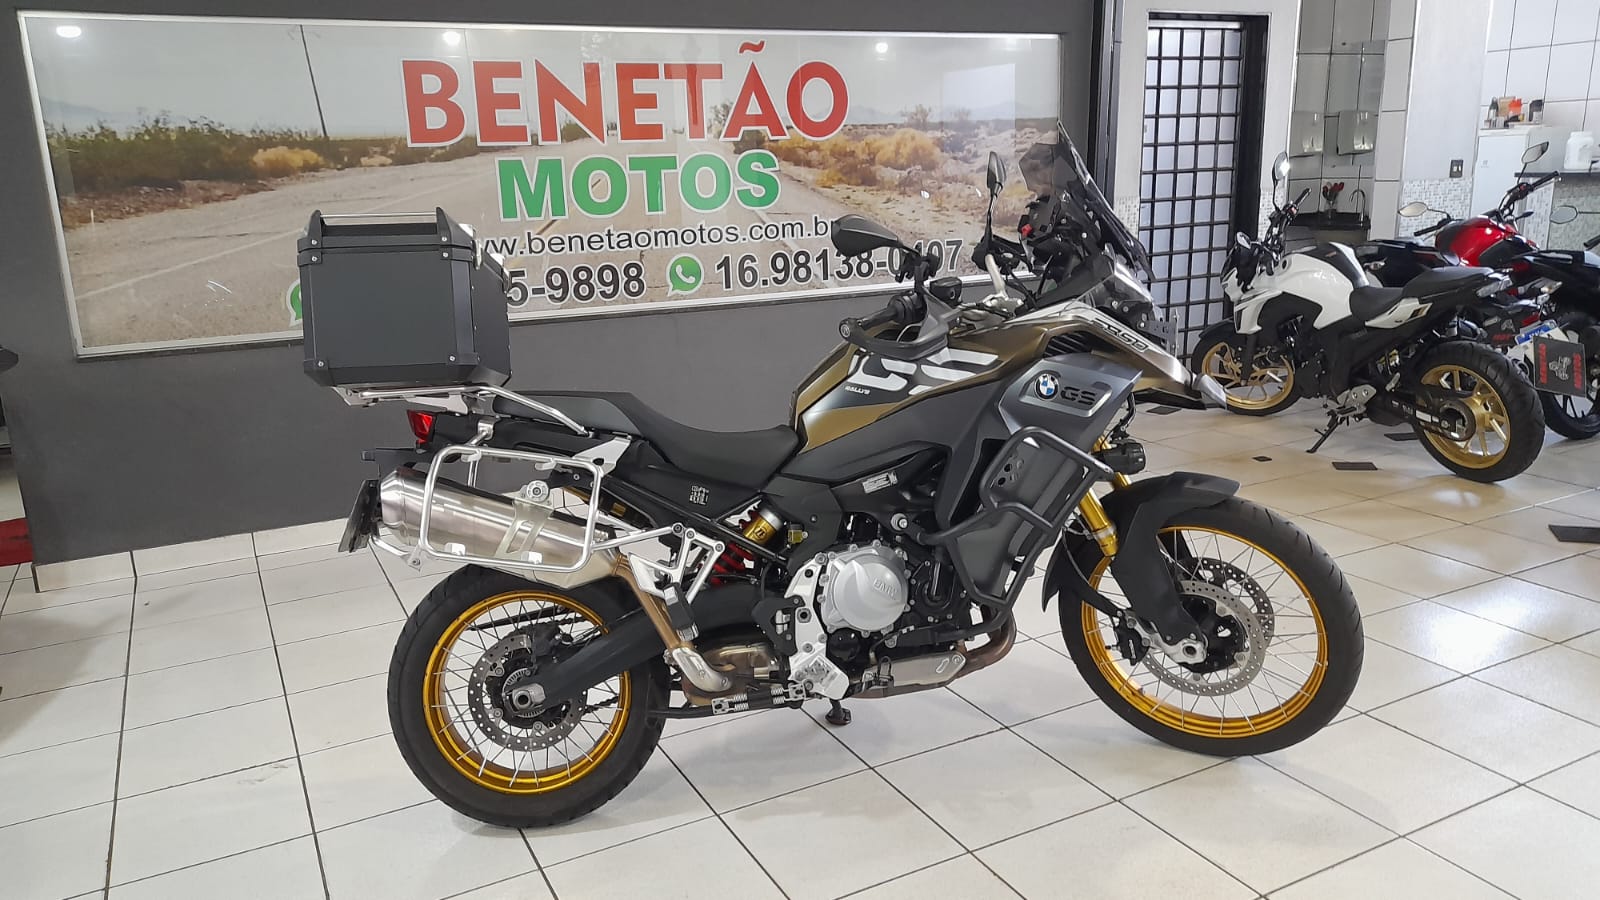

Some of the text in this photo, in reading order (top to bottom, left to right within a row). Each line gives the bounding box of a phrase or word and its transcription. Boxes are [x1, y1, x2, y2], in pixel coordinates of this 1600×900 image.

[401, 40, 849, 145] BENETÃO
[498, 149, 780, 219] MOTOS
[484, 216, 835, 255] w.benetaomotos.com.b
[716, 239, 963, 289] 16.98138-007
[1060, 386, 1097, 406] GS
